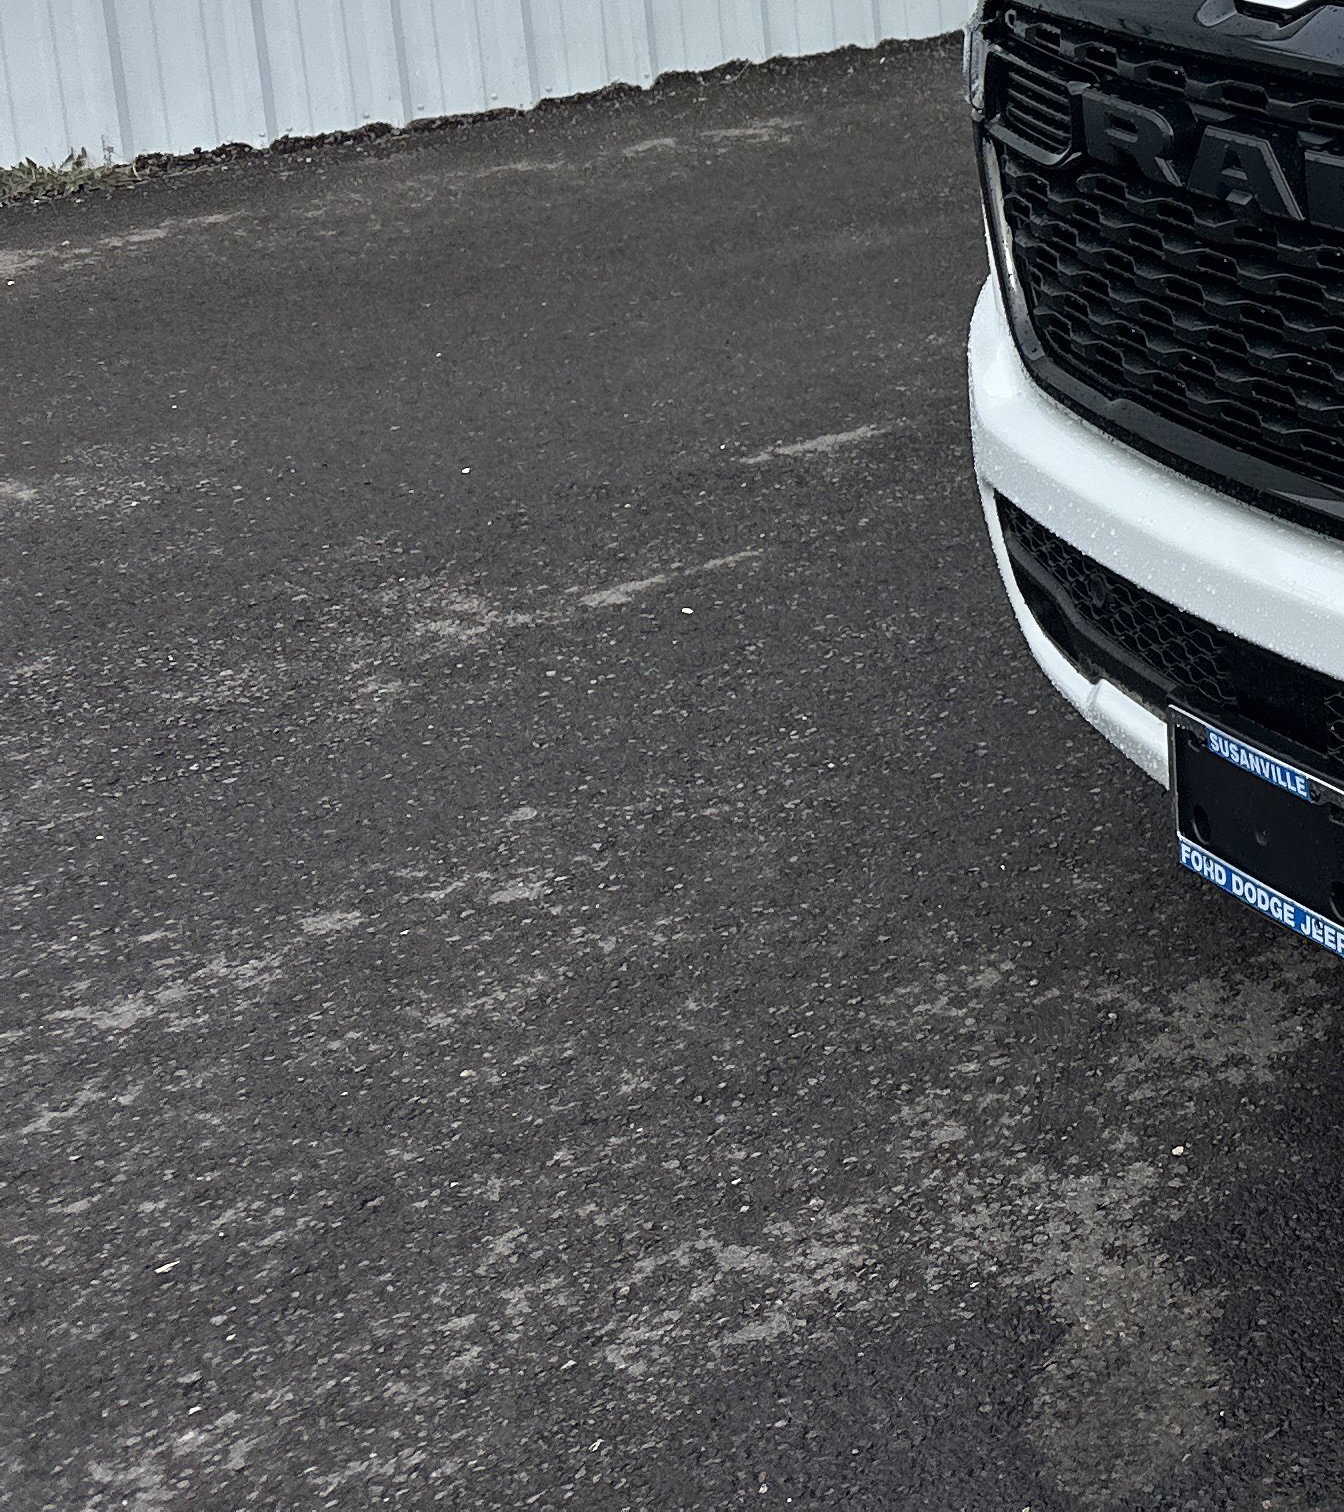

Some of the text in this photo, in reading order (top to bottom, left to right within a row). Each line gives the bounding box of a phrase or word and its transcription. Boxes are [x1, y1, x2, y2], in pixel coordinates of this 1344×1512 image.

[1208, 731, 1308, 797] SUSANVILLE
[1180, 841, 1227, 886] FORD
[1231, 873, 1296, 928] DODGE
